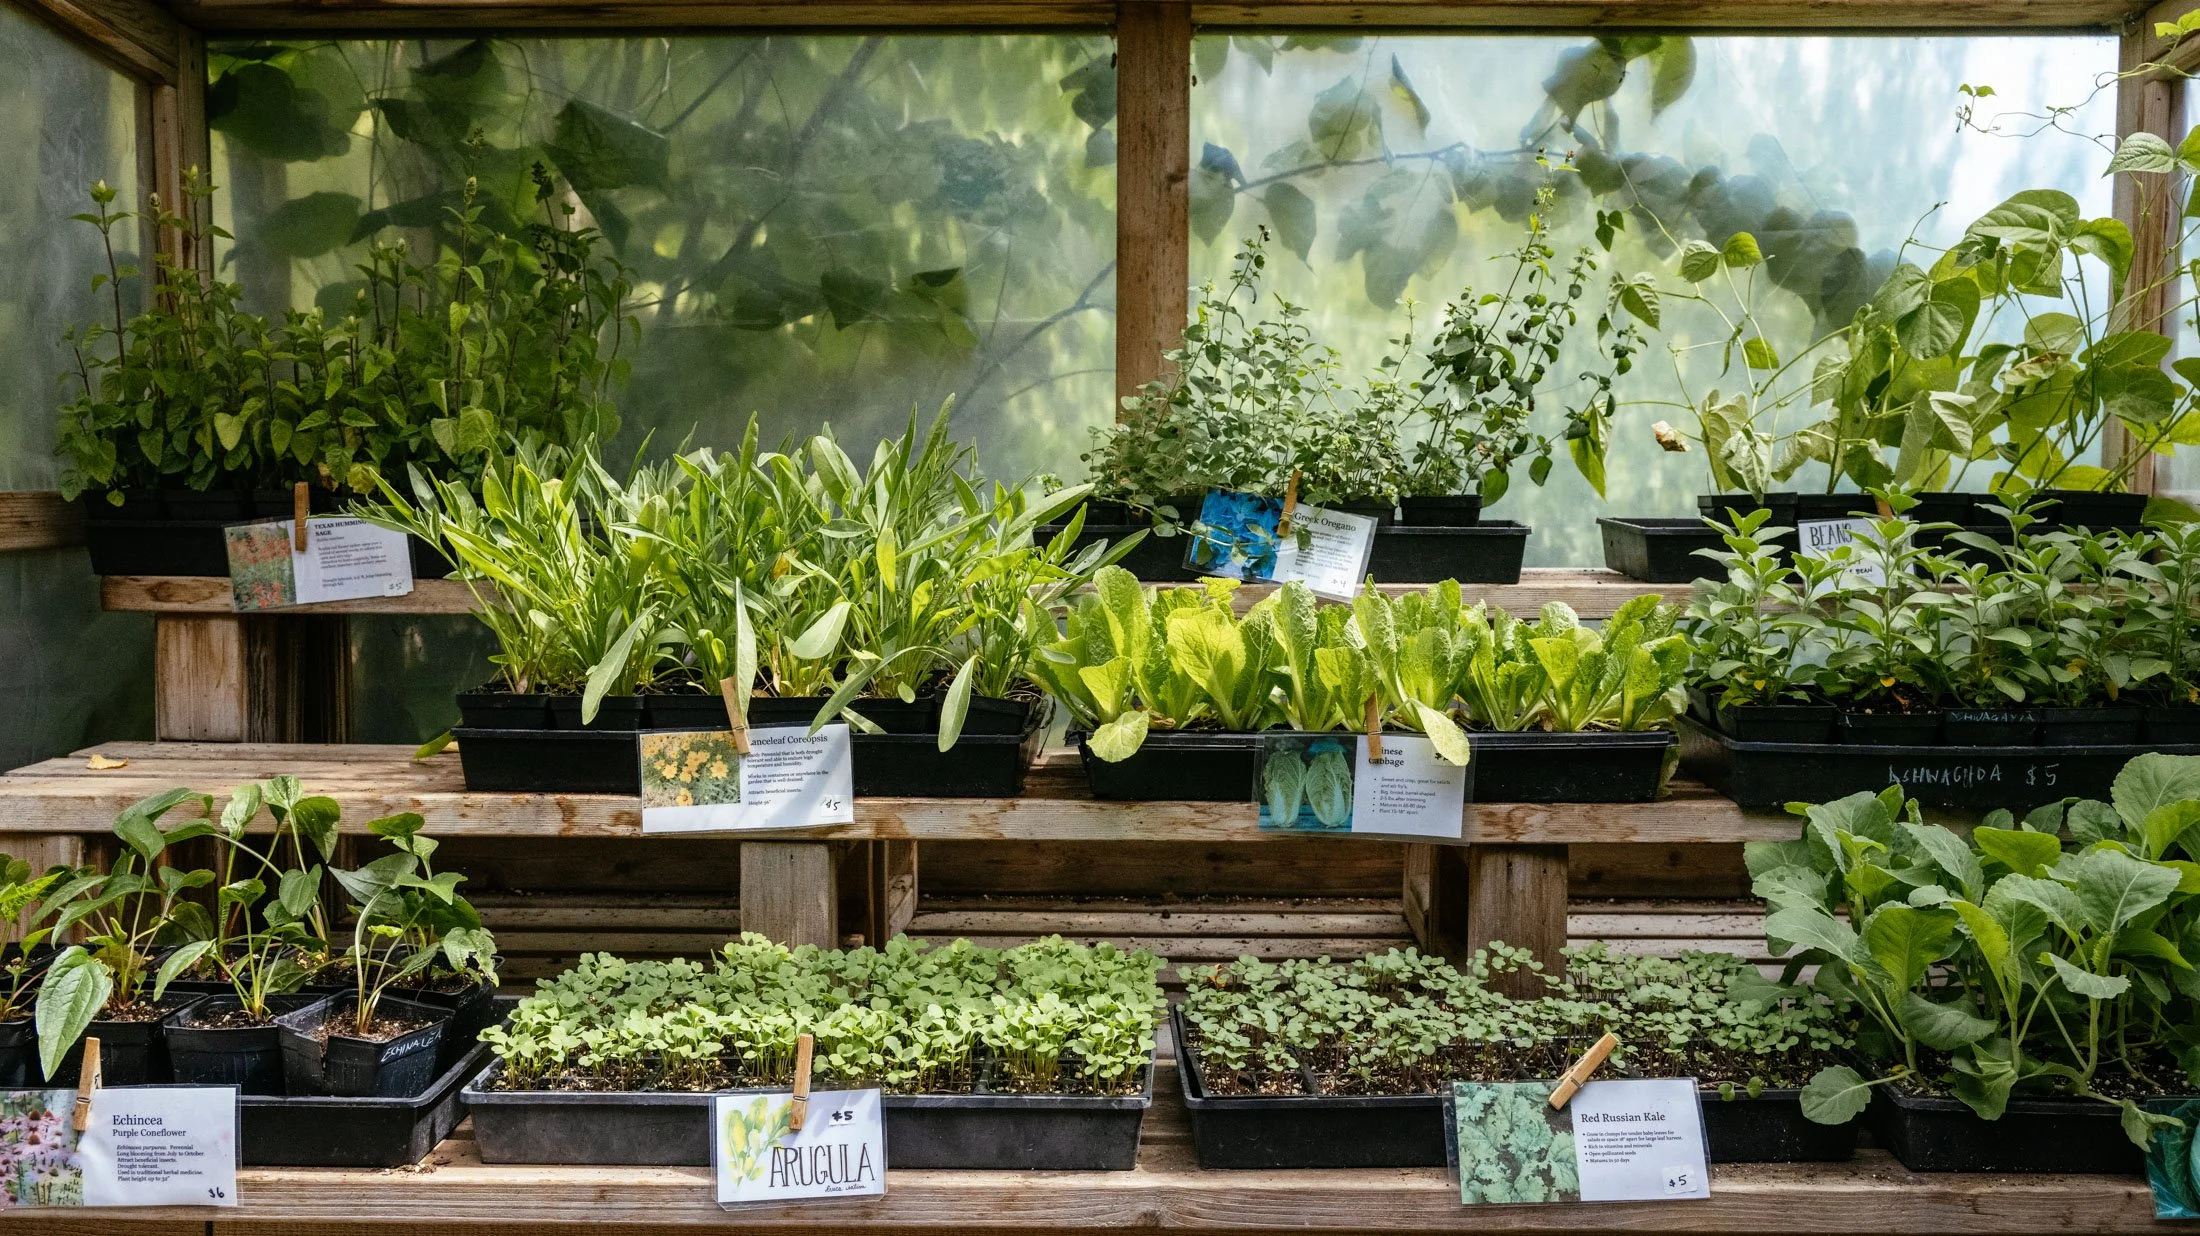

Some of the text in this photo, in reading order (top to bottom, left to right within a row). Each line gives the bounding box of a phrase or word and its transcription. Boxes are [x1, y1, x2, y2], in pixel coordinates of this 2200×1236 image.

[314, 522, 334, 530] TEXAS
[1321, 518, 1356, 532] Oregano
[1809, 523, 1852, 546] BEANS
[750, 734, 828, 746] anceleaf Coreopsis
[1381, 747, 1403, 756] inese
[112, 1114, 163, 1125] Echincea
[832, 1110, 853, 1122] $5
[1581, 1112, 1666, 1122] Red Russian Kale
[112, 1128, 186, 1138] Purple Coneflower
[770, 1142, 875, 1188] ARUGULA
[1669, 1174, 1687, 1188] $5
